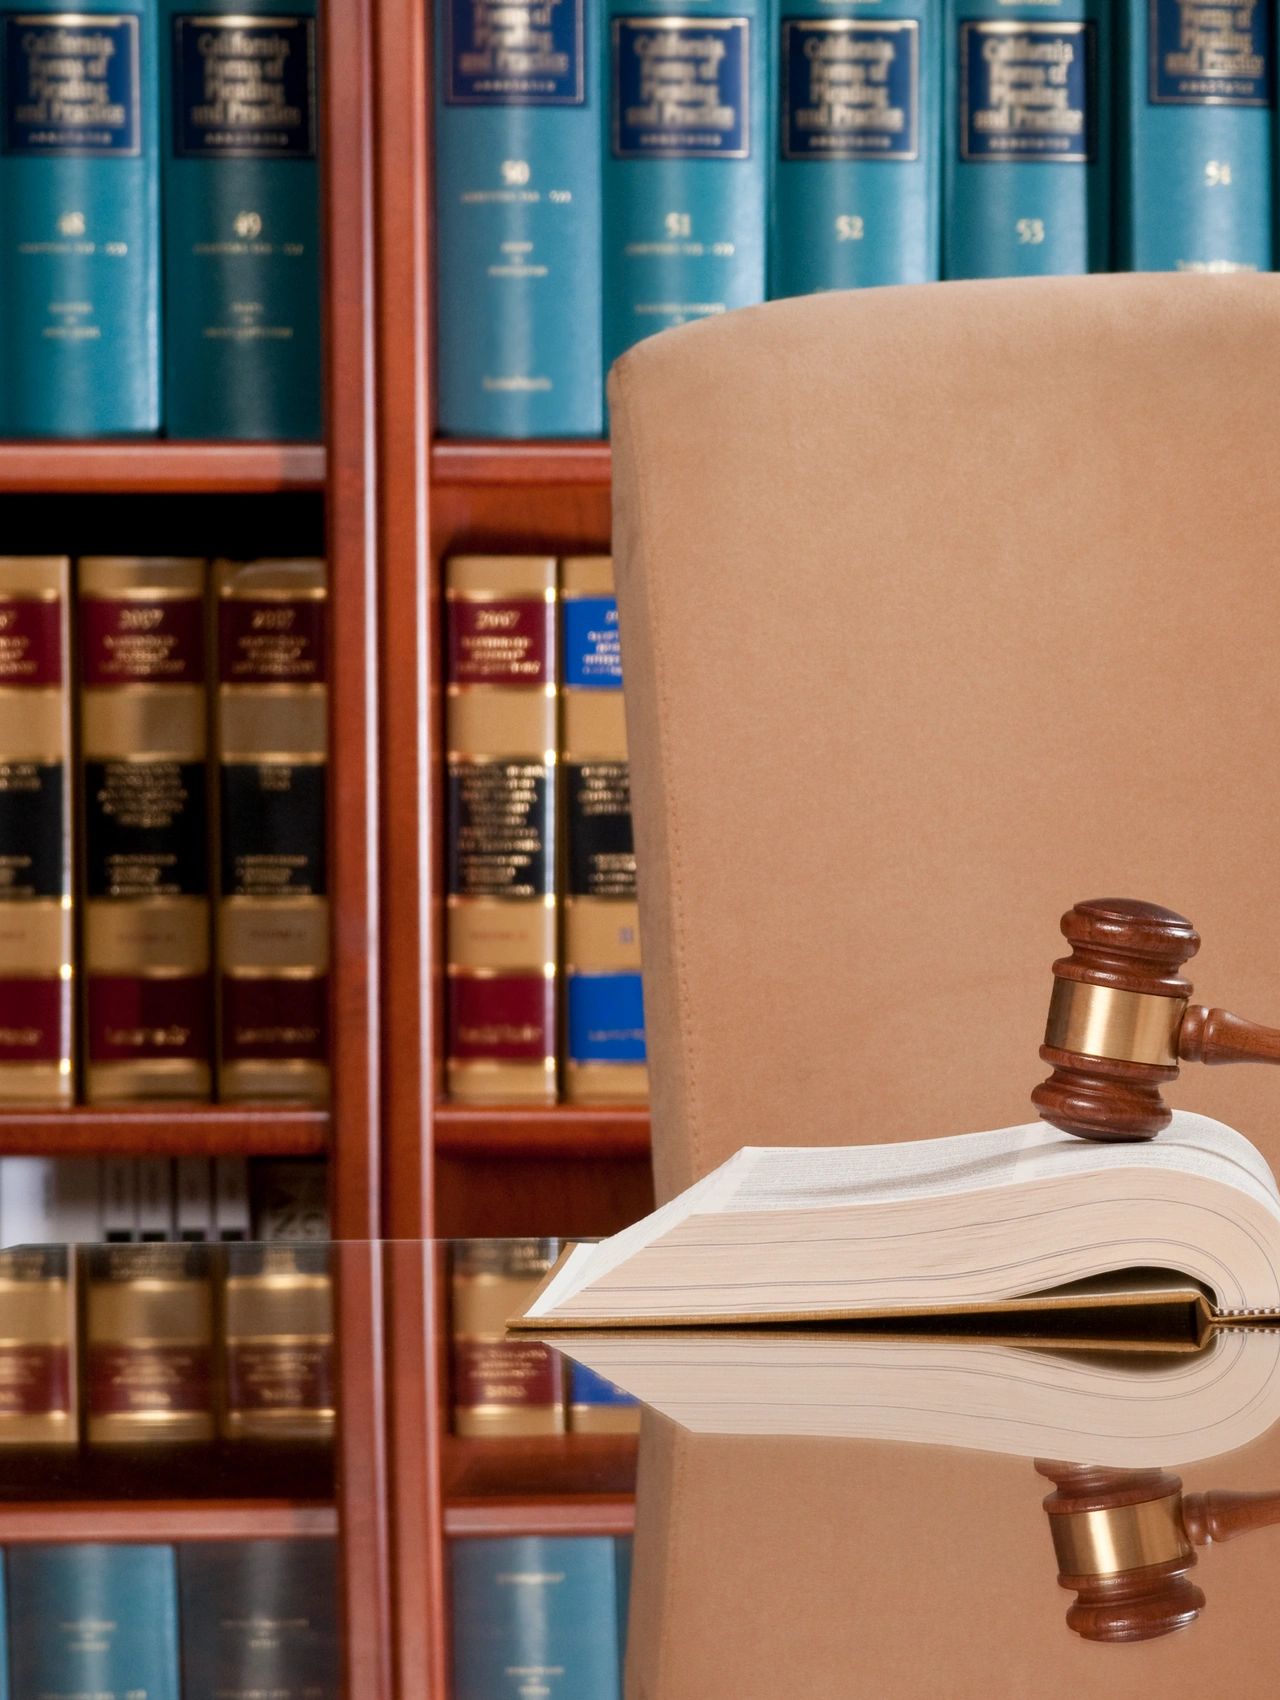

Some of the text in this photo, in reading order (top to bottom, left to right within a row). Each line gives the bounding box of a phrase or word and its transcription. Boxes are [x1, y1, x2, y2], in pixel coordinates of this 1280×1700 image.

[22, 32, 114, 55] California
[198, 33, 289, 55] California
[635, 35, 725, 58] California
[805, 37, 894, 60] California
[983, 39, 1073, 63] California
[835, 215, 864, 242] 52
[1016, 218, 1045, 244] 53
